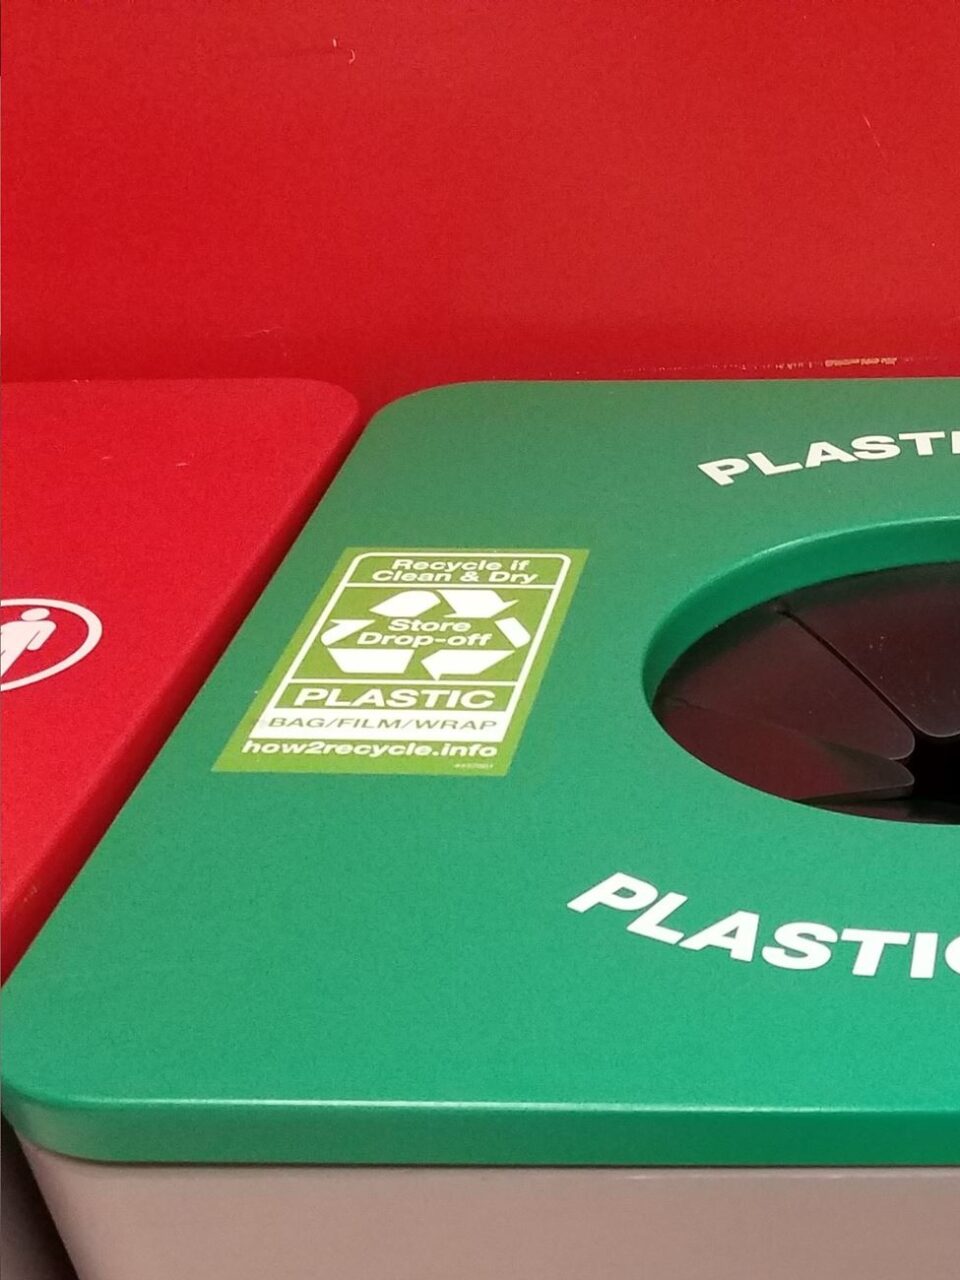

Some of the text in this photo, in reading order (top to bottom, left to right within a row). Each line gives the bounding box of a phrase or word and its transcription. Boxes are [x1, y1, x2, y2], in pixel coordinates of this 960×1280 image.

[391, 559, 530, 572] Recycle if
[371, 570, 538, 584] Clean & Dry
[387, 619, 472, 632] Store
[356, 632, 493, 648] Drop-off
[293, 688, 496, 709] PLASTIC
[267, 717, 497, 731] BAG/FILM/WRAP
[241, 740, 498, 758] how2recycle.info
